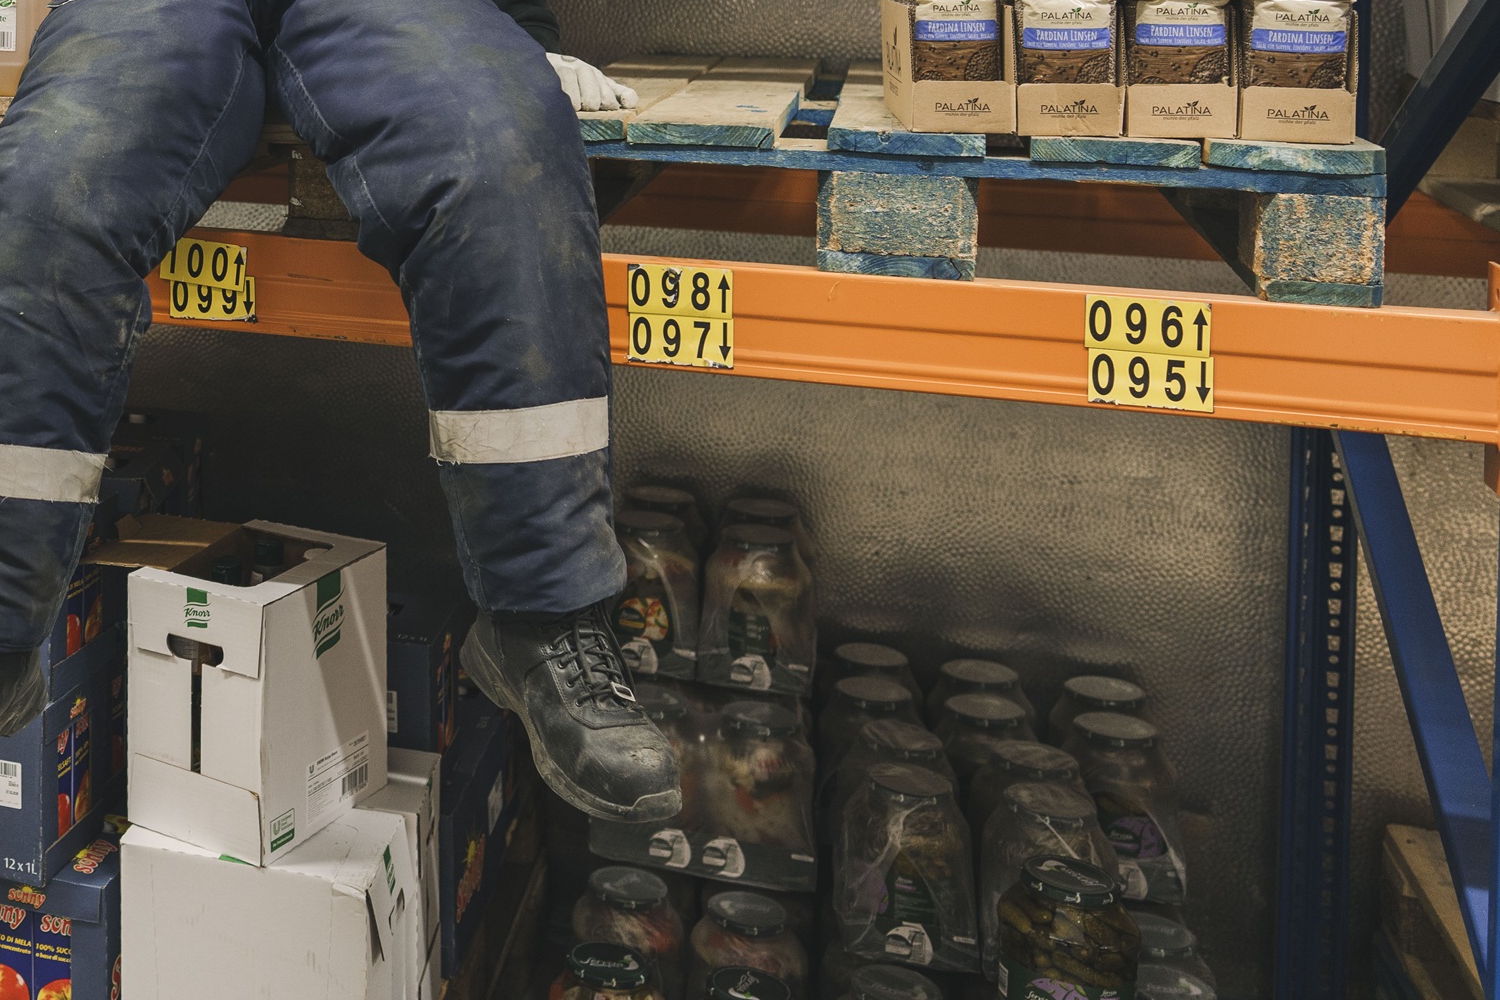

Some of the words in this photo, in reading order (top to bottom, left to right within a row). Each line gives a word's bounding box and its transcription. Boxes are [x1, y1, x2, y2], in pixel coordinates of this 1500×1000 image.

[932, 3, 980, 12] PALATINA
[1156, 7, 1209, 16] PALATINA
[1041, 12, 1092, 20] PALATINA
[1275, 13, 1330, 22] PALATINA
[928, 22, 959, 32] PARDINA
[960, 22, 986, 32] LINSEN
[1150, 25, 1184, 37] PARDINA
[1186, 26, 1213, 38] LINSEN
[1036, 29, 1068, 41] PARDINA
[1070, 30, 1097, 41] LINSEN
[1268, 31, 1303, 43] PARDINA
[1305, 32, 1333, 44] LINSEN
[935, 102, 991, 112] PALATINA
[1040, 104, 1098, 114] PALATINA
[1152, 105, 1211, 115] PALATINA
[1267, 108, 1329, 119] PALATINA
[169, 243, 229, 282] 100
[631, 267, 712, 312] 098
[172, 281, 237, 315] 099
[1088, 299, 1185, 348] 096
[632, 318, 712, 359] 097
[1092, 353, 1187, 402] 095
[184, 606, 211, 619] Knorr
[312, 603, 346, 640] Knorr
[3, 857, 16, 870] 12
[17, 861, 24, 870] x
[40, 914, 72, 937] son
[6, 935, 14, 943] DI
[15, 937, 32, 947] MELA
[35, 943, 54, 953] 100%
